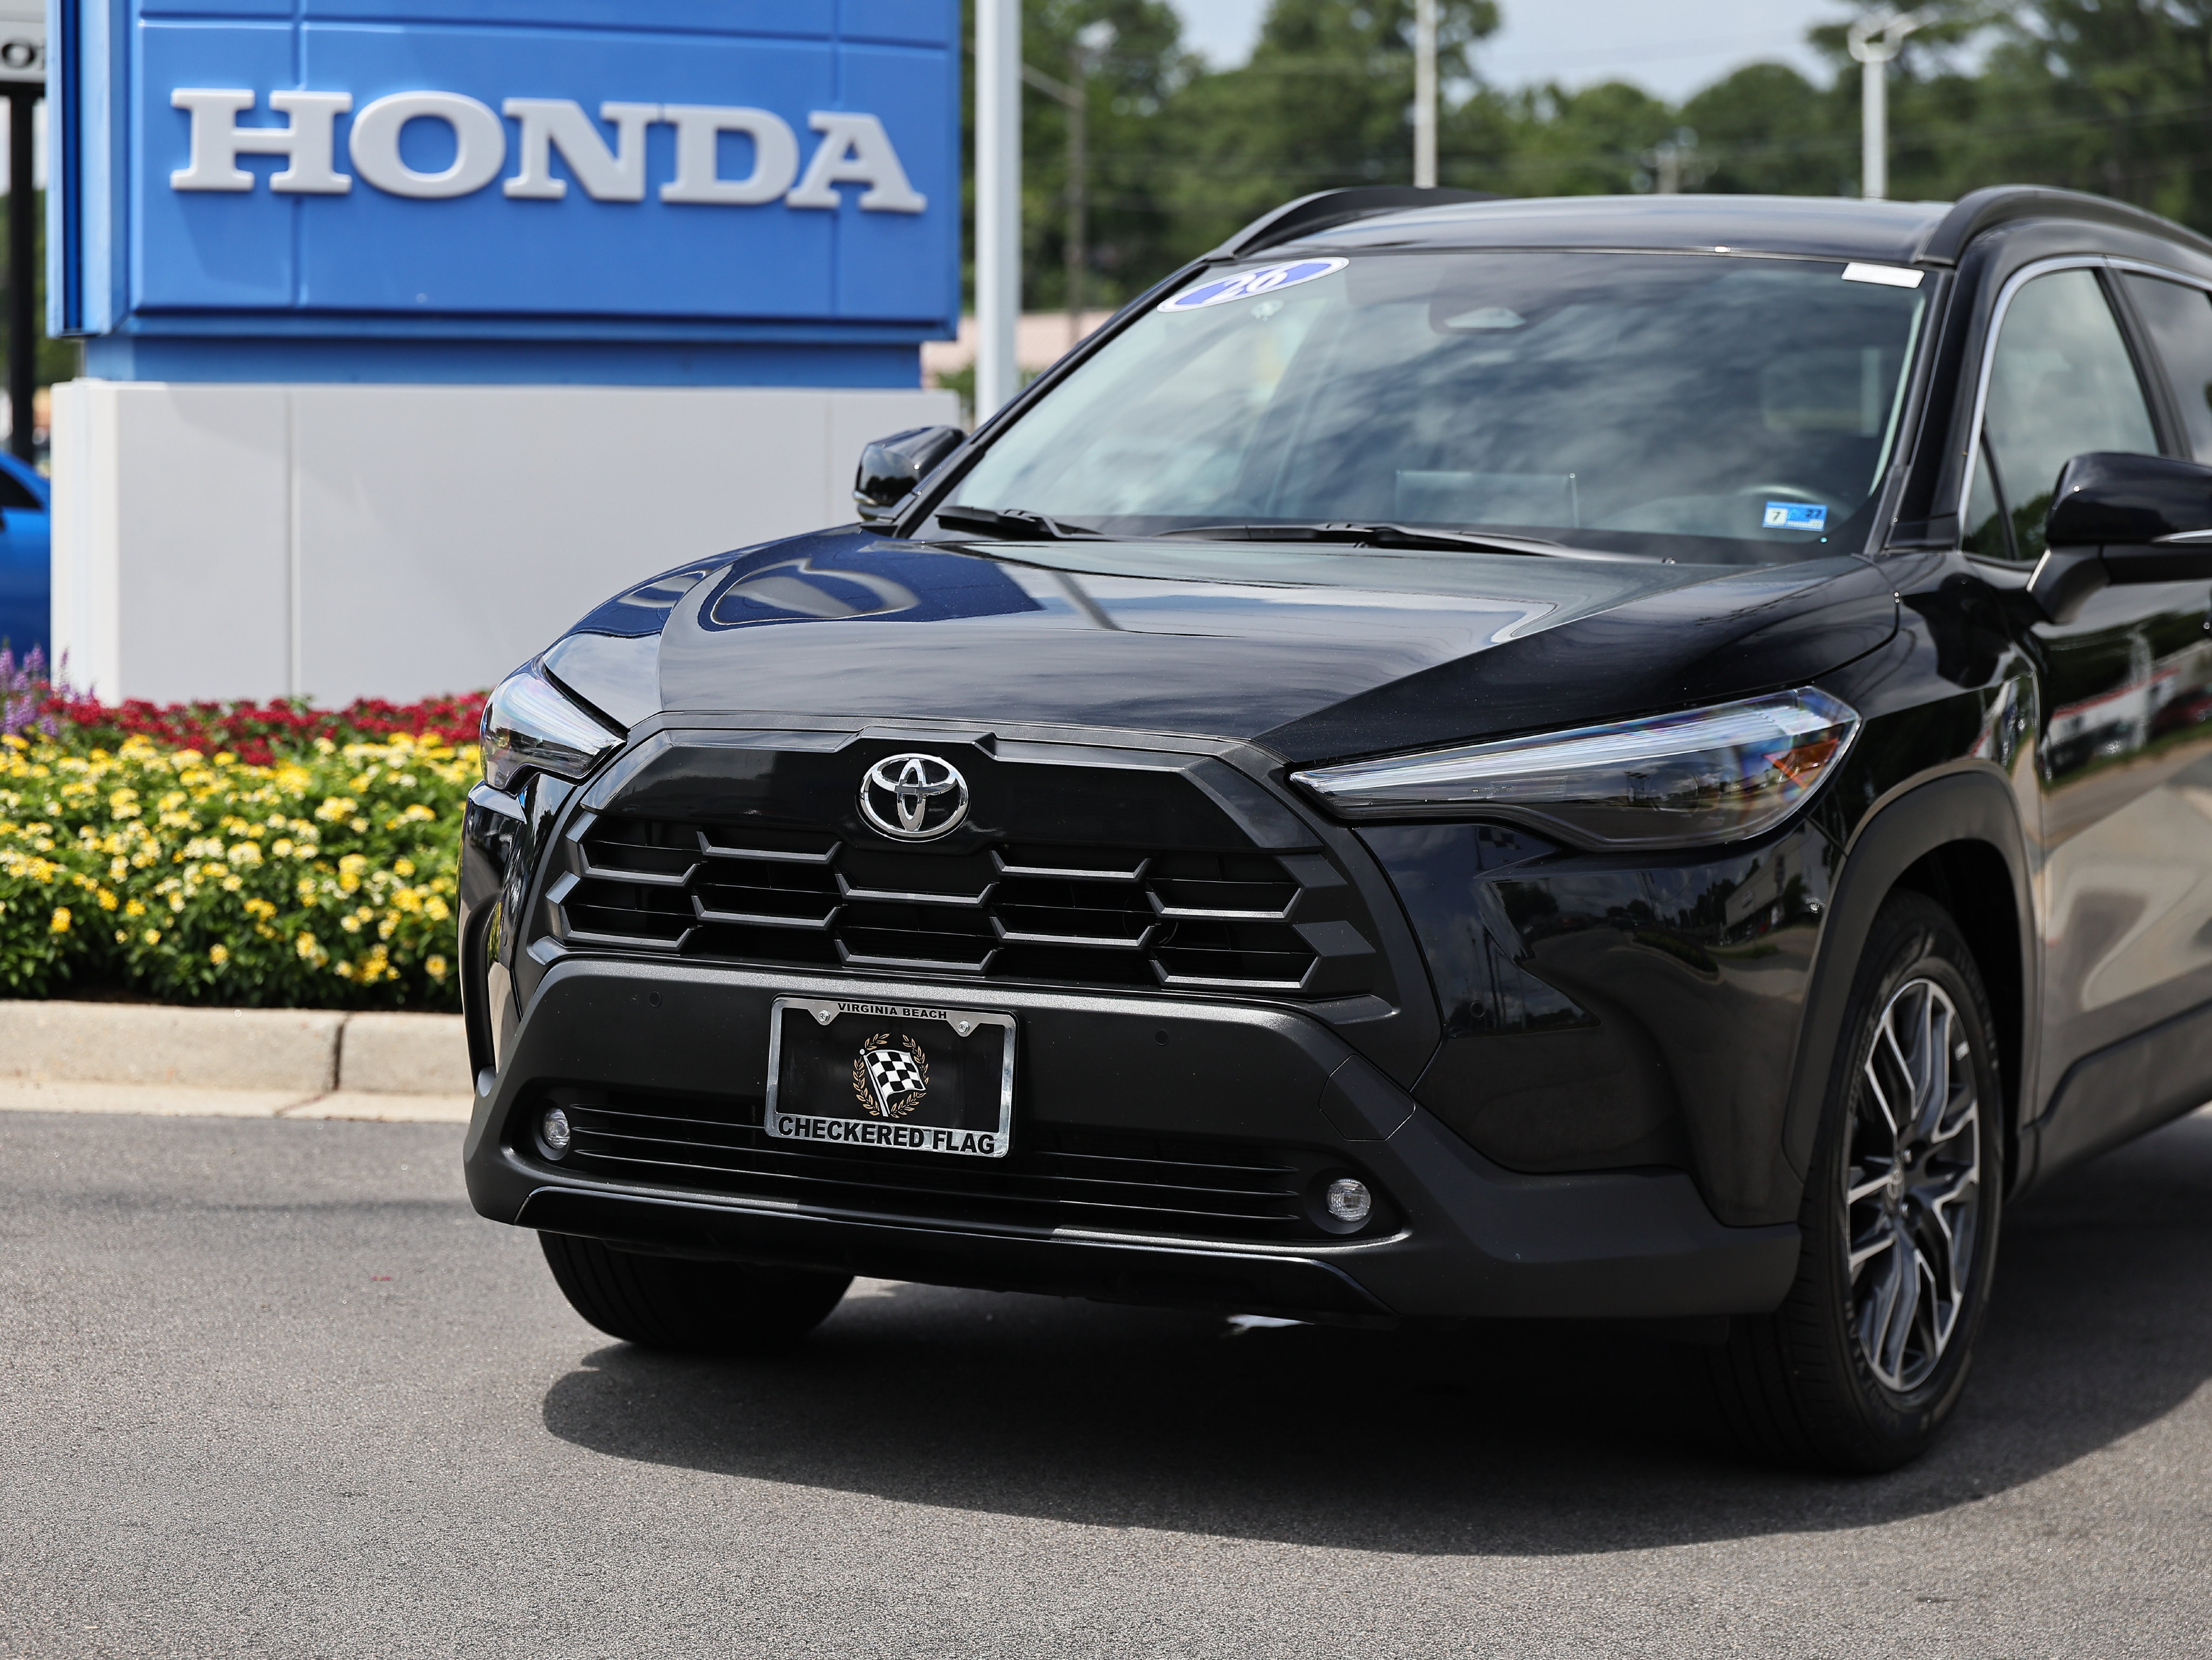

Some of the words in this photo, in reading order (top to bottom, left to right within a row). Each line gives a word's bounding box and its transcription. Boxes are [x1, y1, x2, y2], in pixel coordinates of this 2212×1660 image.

[170, 87, 928, 212] HONDA
[1200, 264, 1301, 303] 26
[1772, 511, 1781, 522] 7
[838, 1003, 898, 1016] VIRGINIA
[903, 1008, 947, 1020] BEACH
[778, 1116, 925, 1148] CHECKERED
[933, 1130, 994, 1154] FLAG
